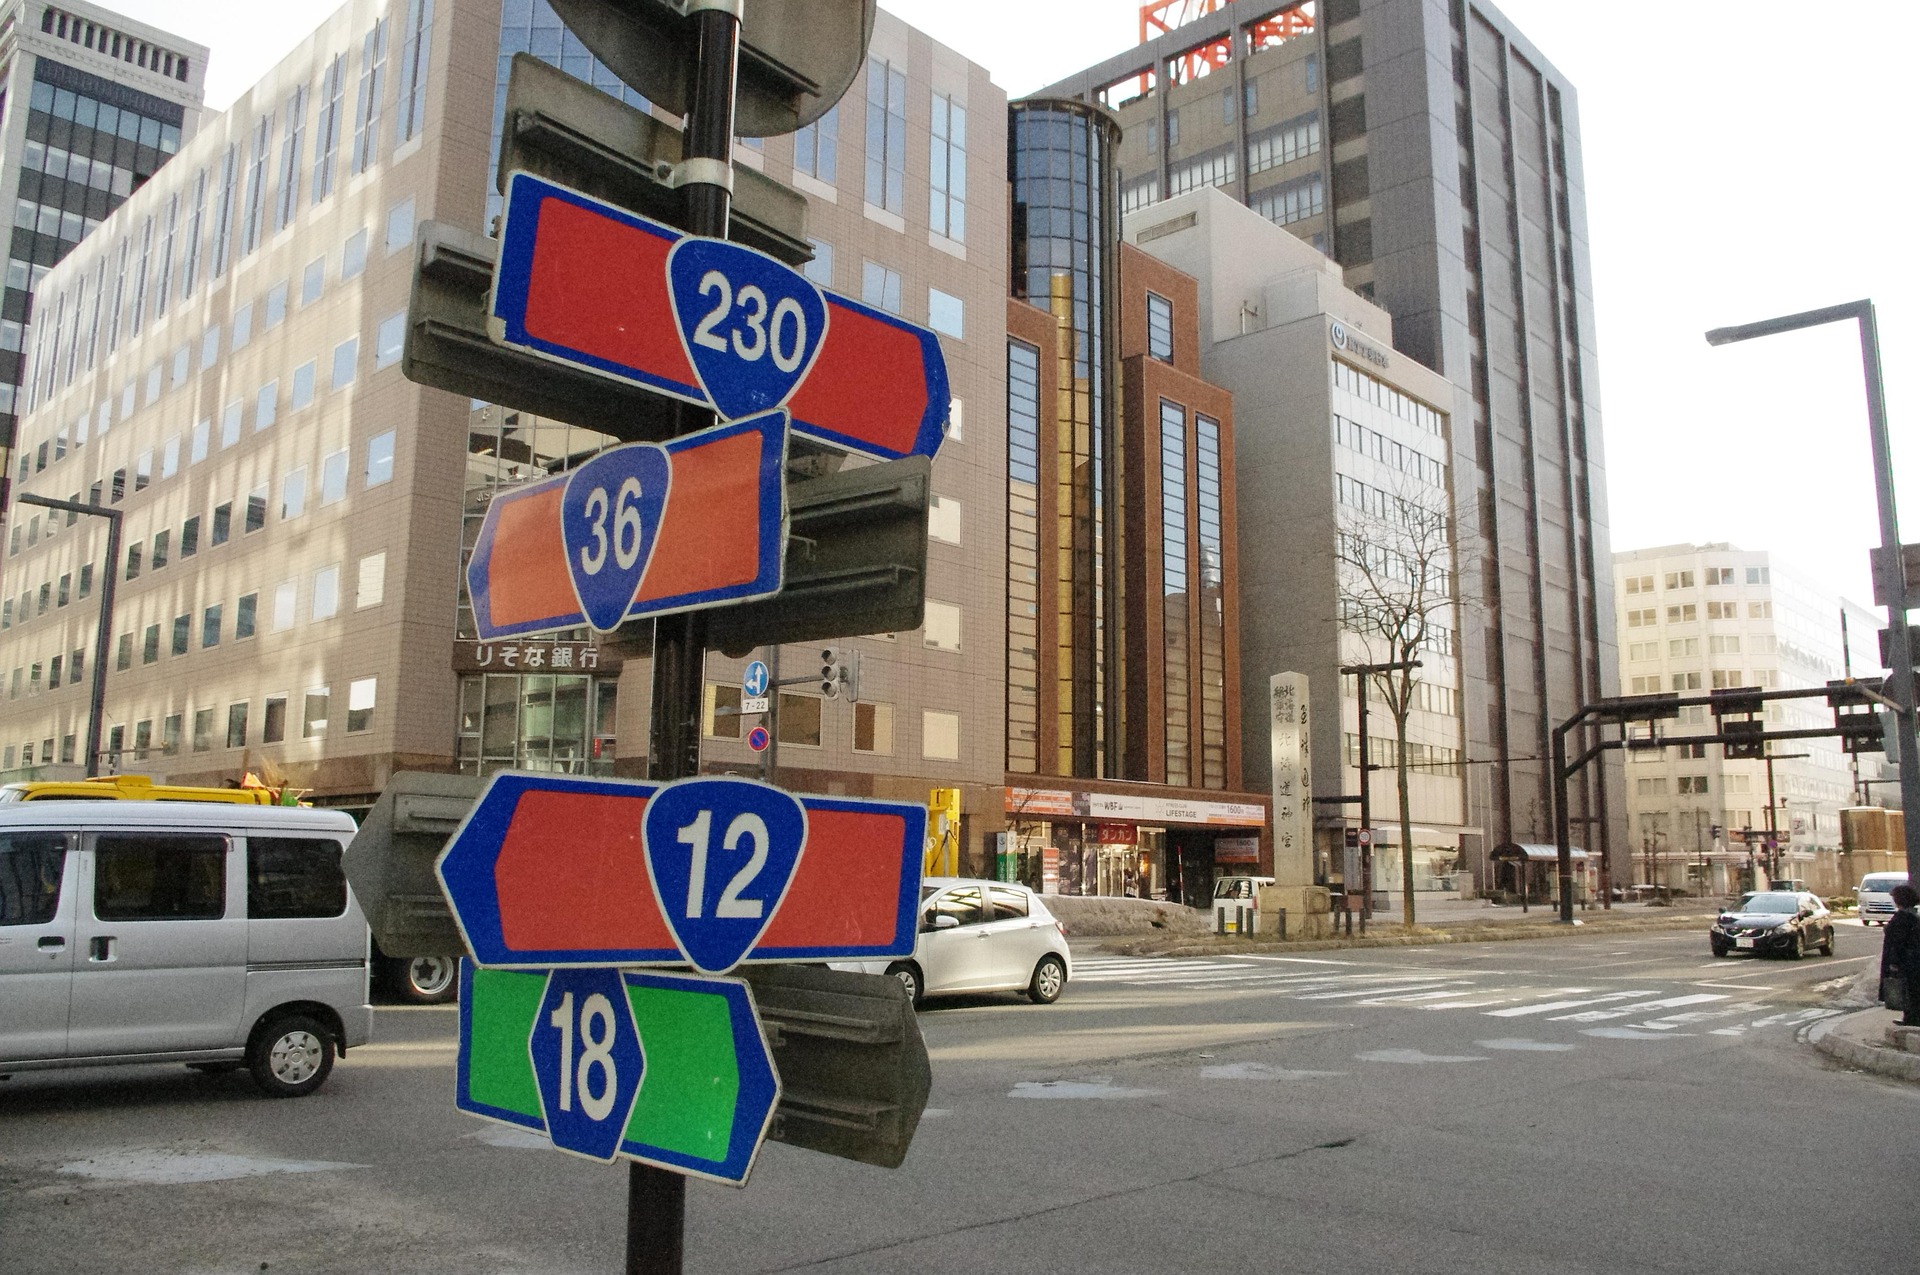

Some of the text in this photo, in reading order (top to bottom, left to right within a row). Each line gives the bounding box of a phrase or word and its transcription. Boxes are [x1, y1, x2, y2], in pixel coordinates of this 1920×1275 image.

[692, 269, 808, 374] 230
[580, 476, 642, 576] 36
[476, 645, 599, 668] りそな銀行
[1165, 810, 1197, 818] LIFESTAGE
[1279, 732, 1293, 848] 北海道神宮
[677, 809, 770, 919] 12
[550, 991, 618, 1122] 18
